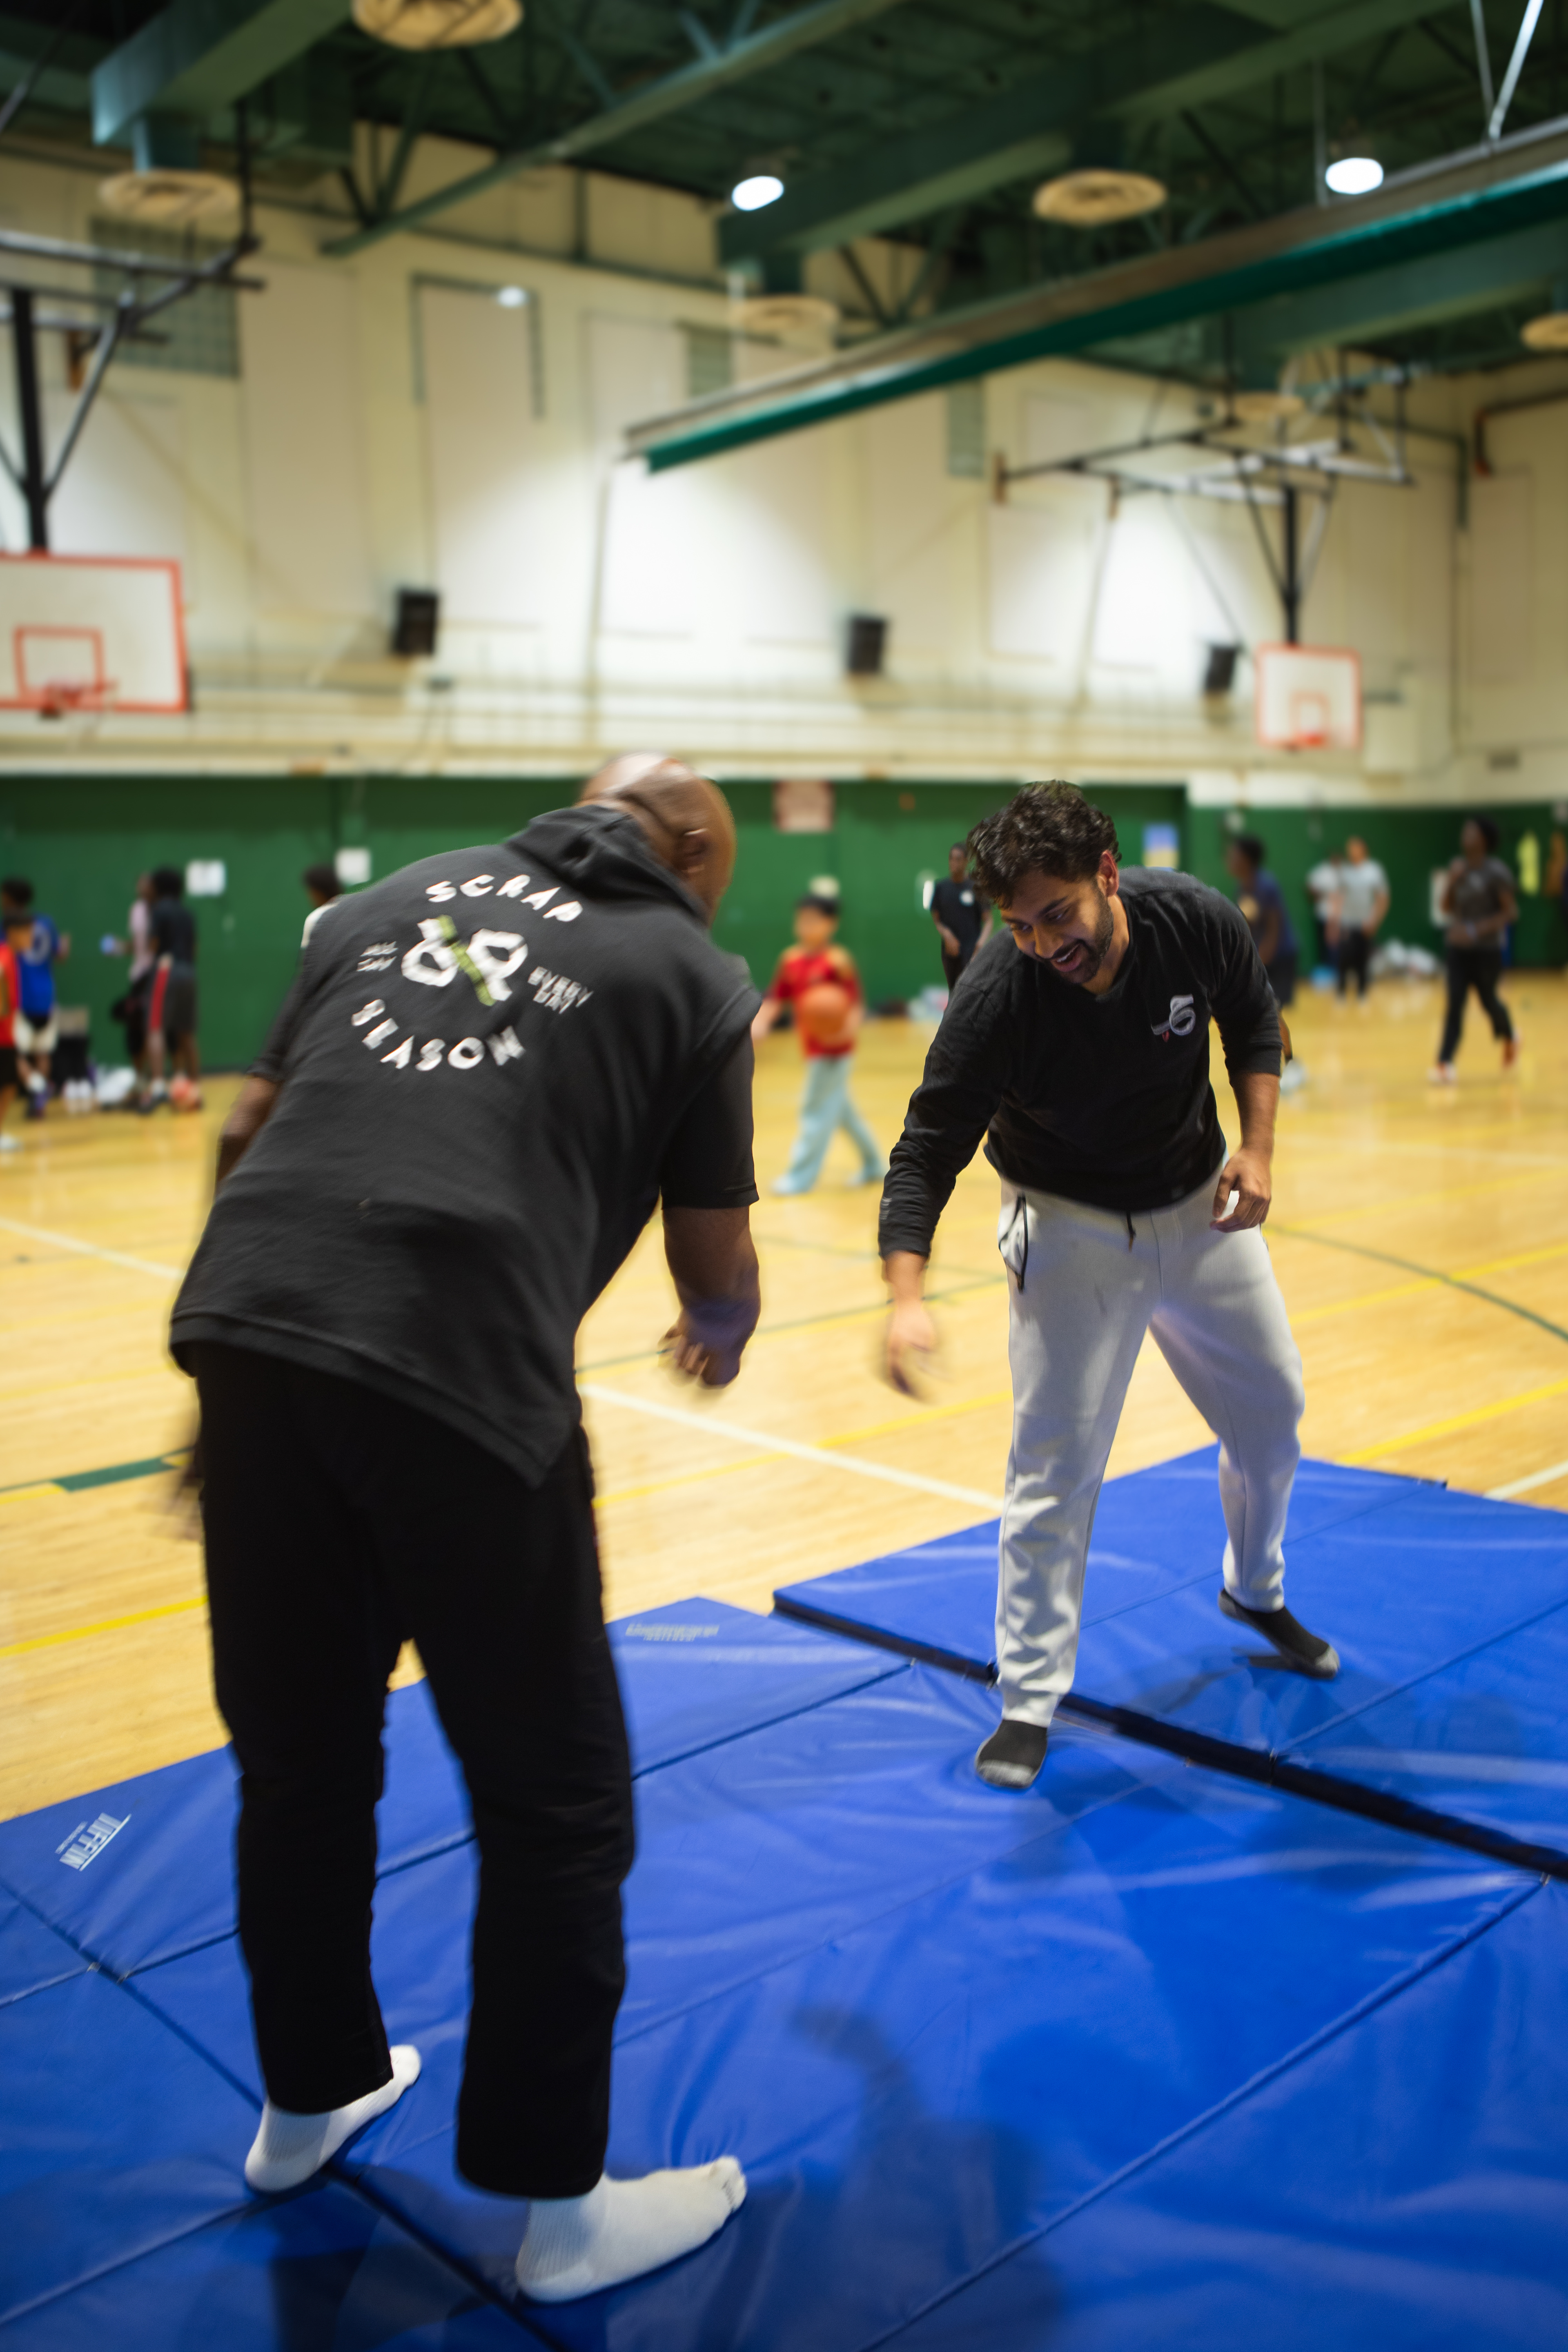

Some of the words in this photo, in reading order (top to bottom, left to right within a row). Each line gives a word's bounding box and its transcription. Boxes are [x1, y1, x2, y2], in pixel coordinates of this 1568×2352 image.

[425, 874, 583, 922] SCRAP
[351, 999, 526, 1071] SEASON
[59, 1812, 131, 1872] TIFFIN
